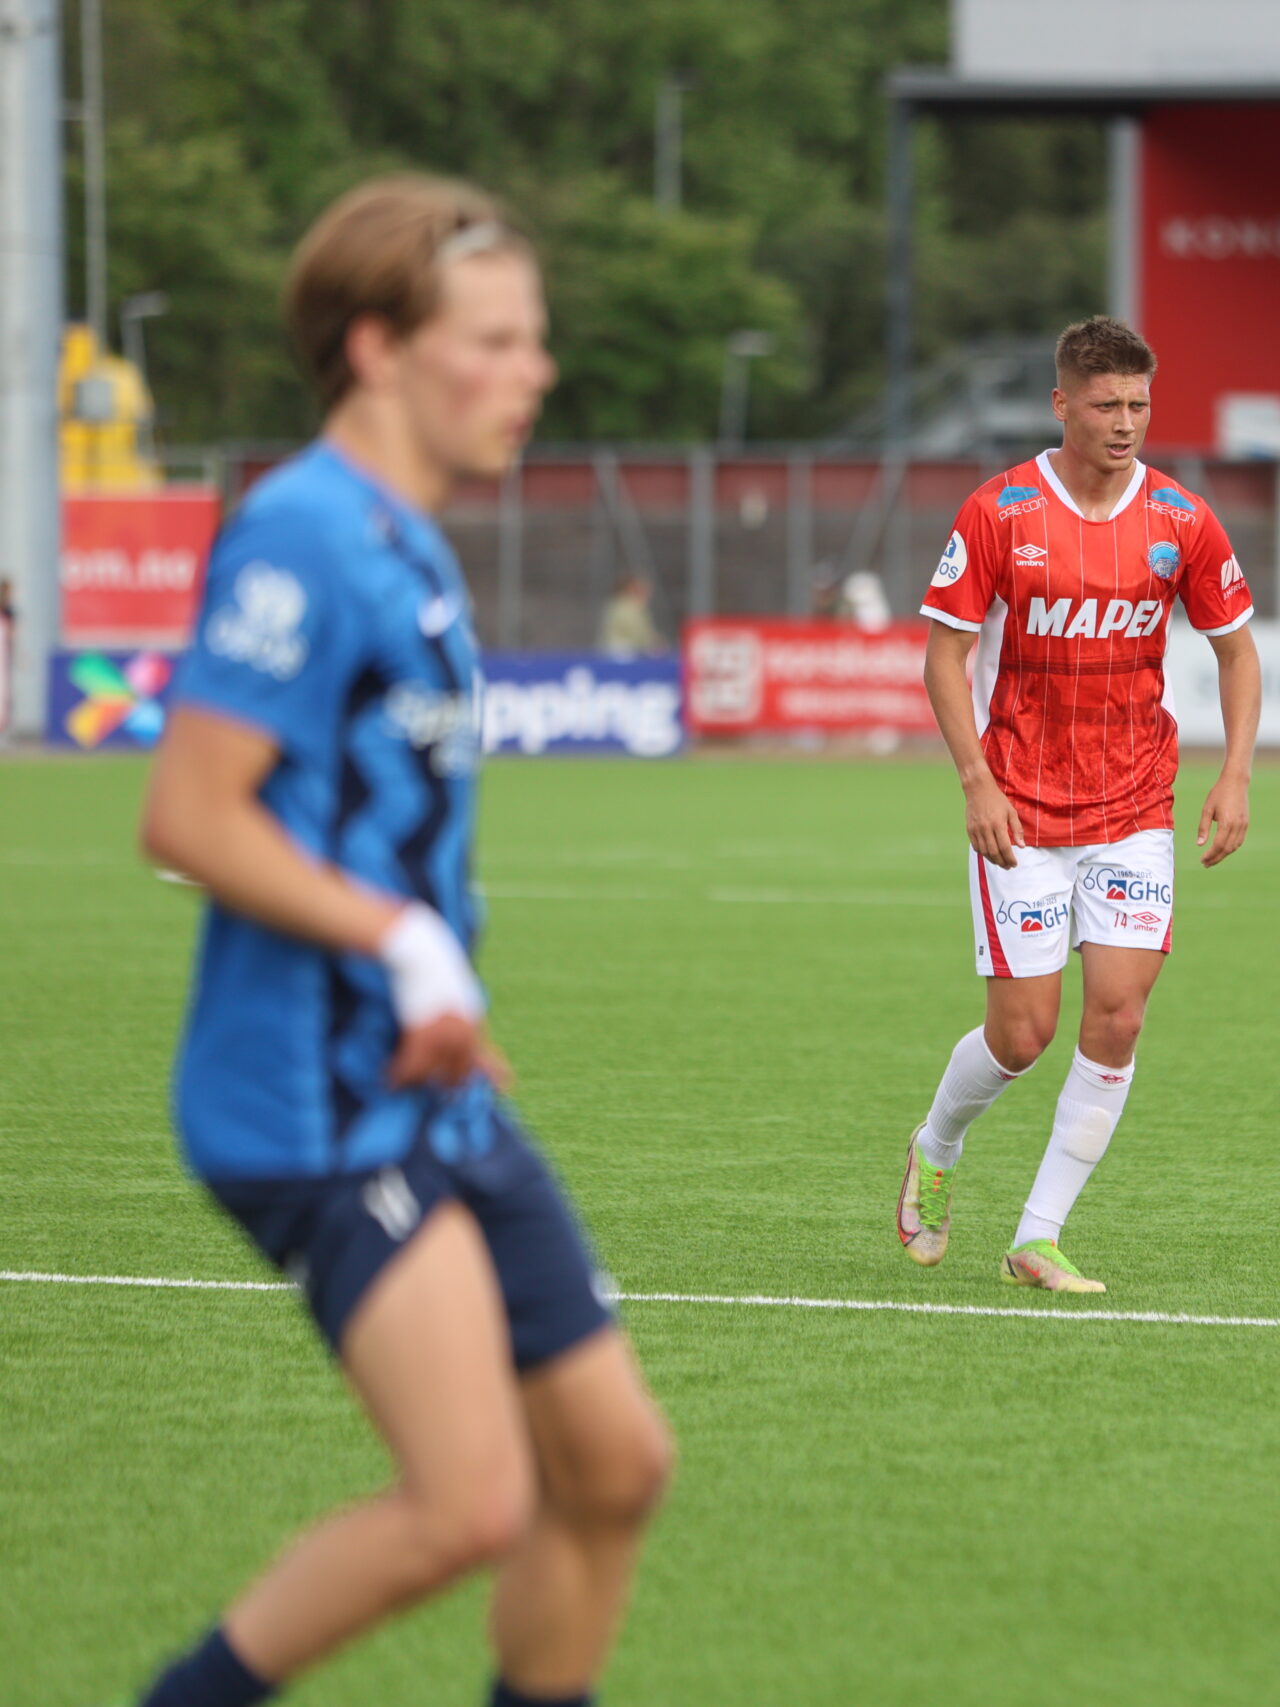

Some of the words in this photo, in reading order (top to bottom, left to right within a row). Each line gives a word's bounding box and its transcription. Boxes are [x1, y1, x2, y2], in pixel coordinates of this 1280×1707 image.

[937, 562, 959, 580] OS
[1016, 559, 1044, 567] umbro
[1026, 597, 1163, 639] MAPEI
[481, 664, 682, 756] pping
[1128, 880, 1171, 904] GHG
[1114, 912, 1127, 929] 14
